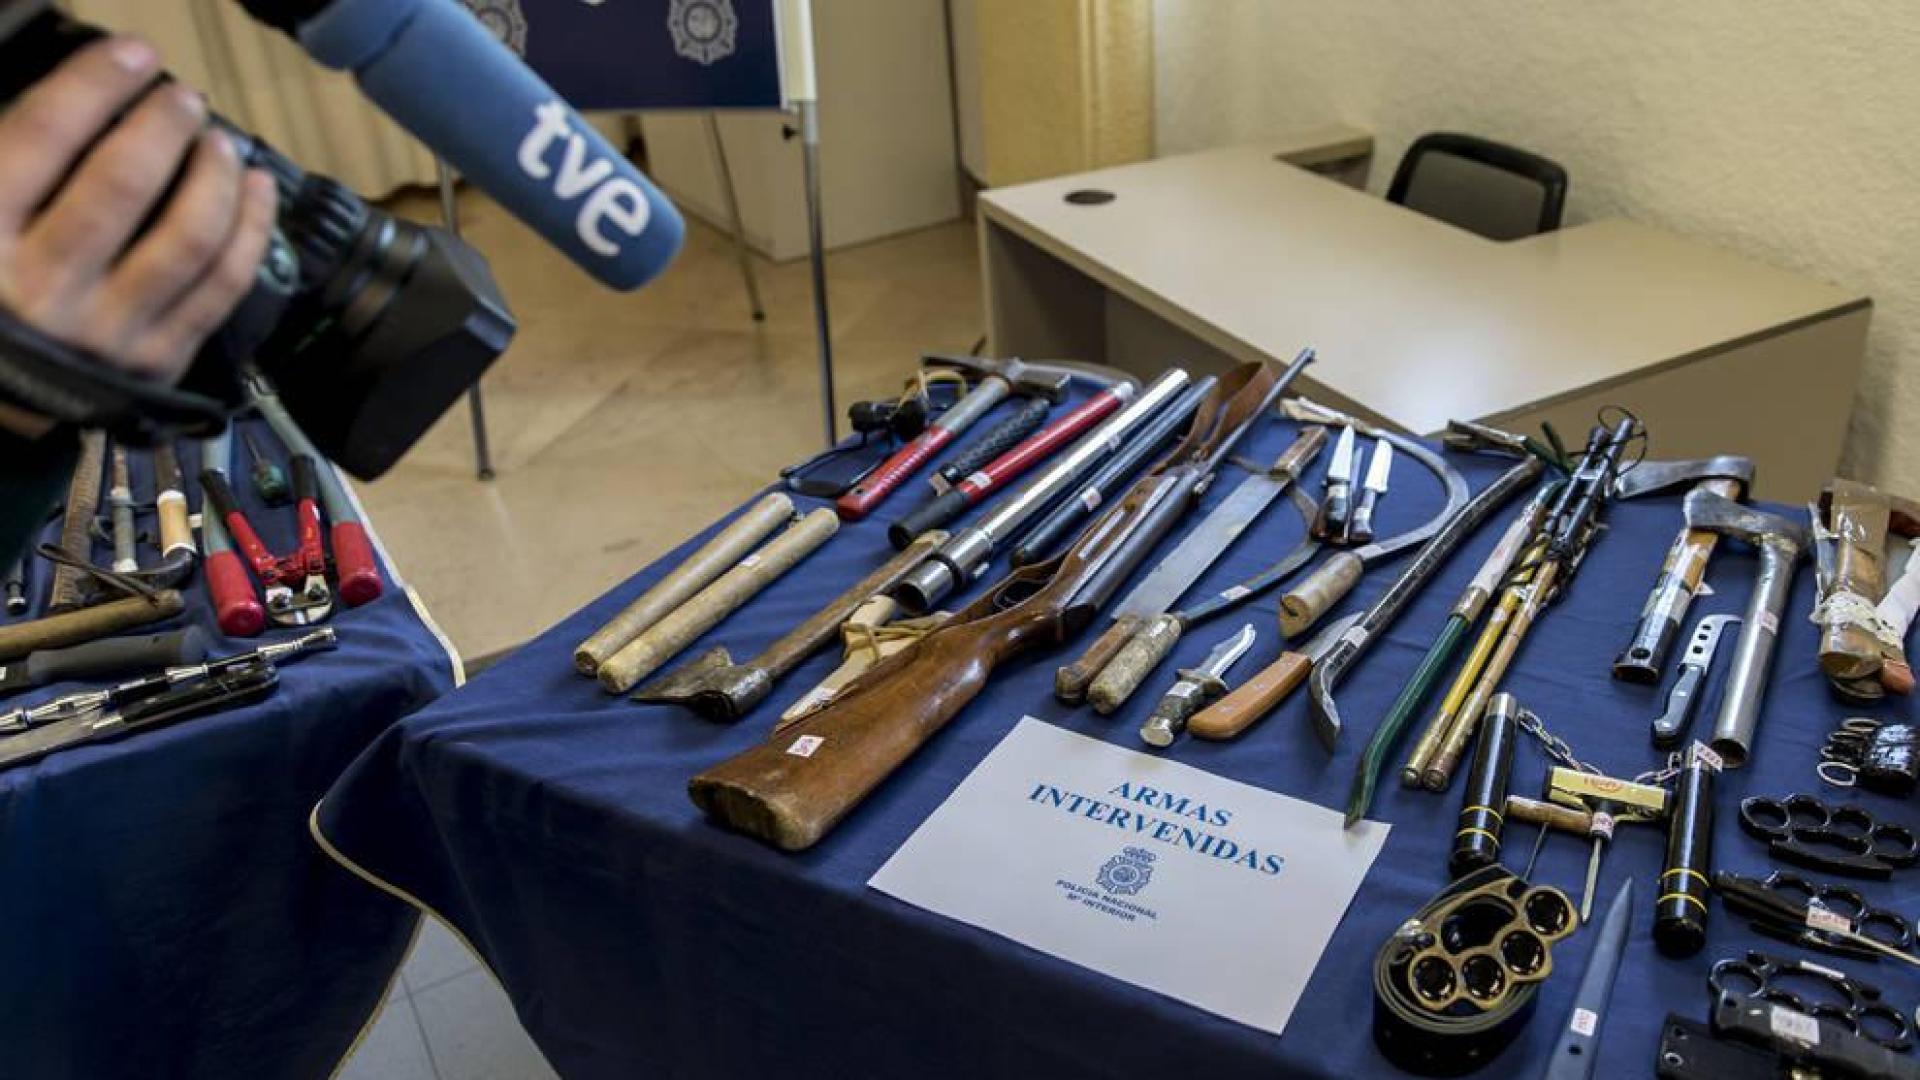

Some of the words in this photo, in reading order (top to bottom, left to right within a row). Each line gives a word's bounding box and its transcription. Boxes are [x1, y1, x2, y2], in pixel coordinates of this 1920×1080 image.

[518, 100, 650, 257] tve
[1108, 782, 1233, 827] ARMAS
[1027, 783, 1285, 876] INTERVENIDAS
[1082, 899, 1136, 922] INTERIOR
[1101, 895, 1157, 920] NACIONAL
